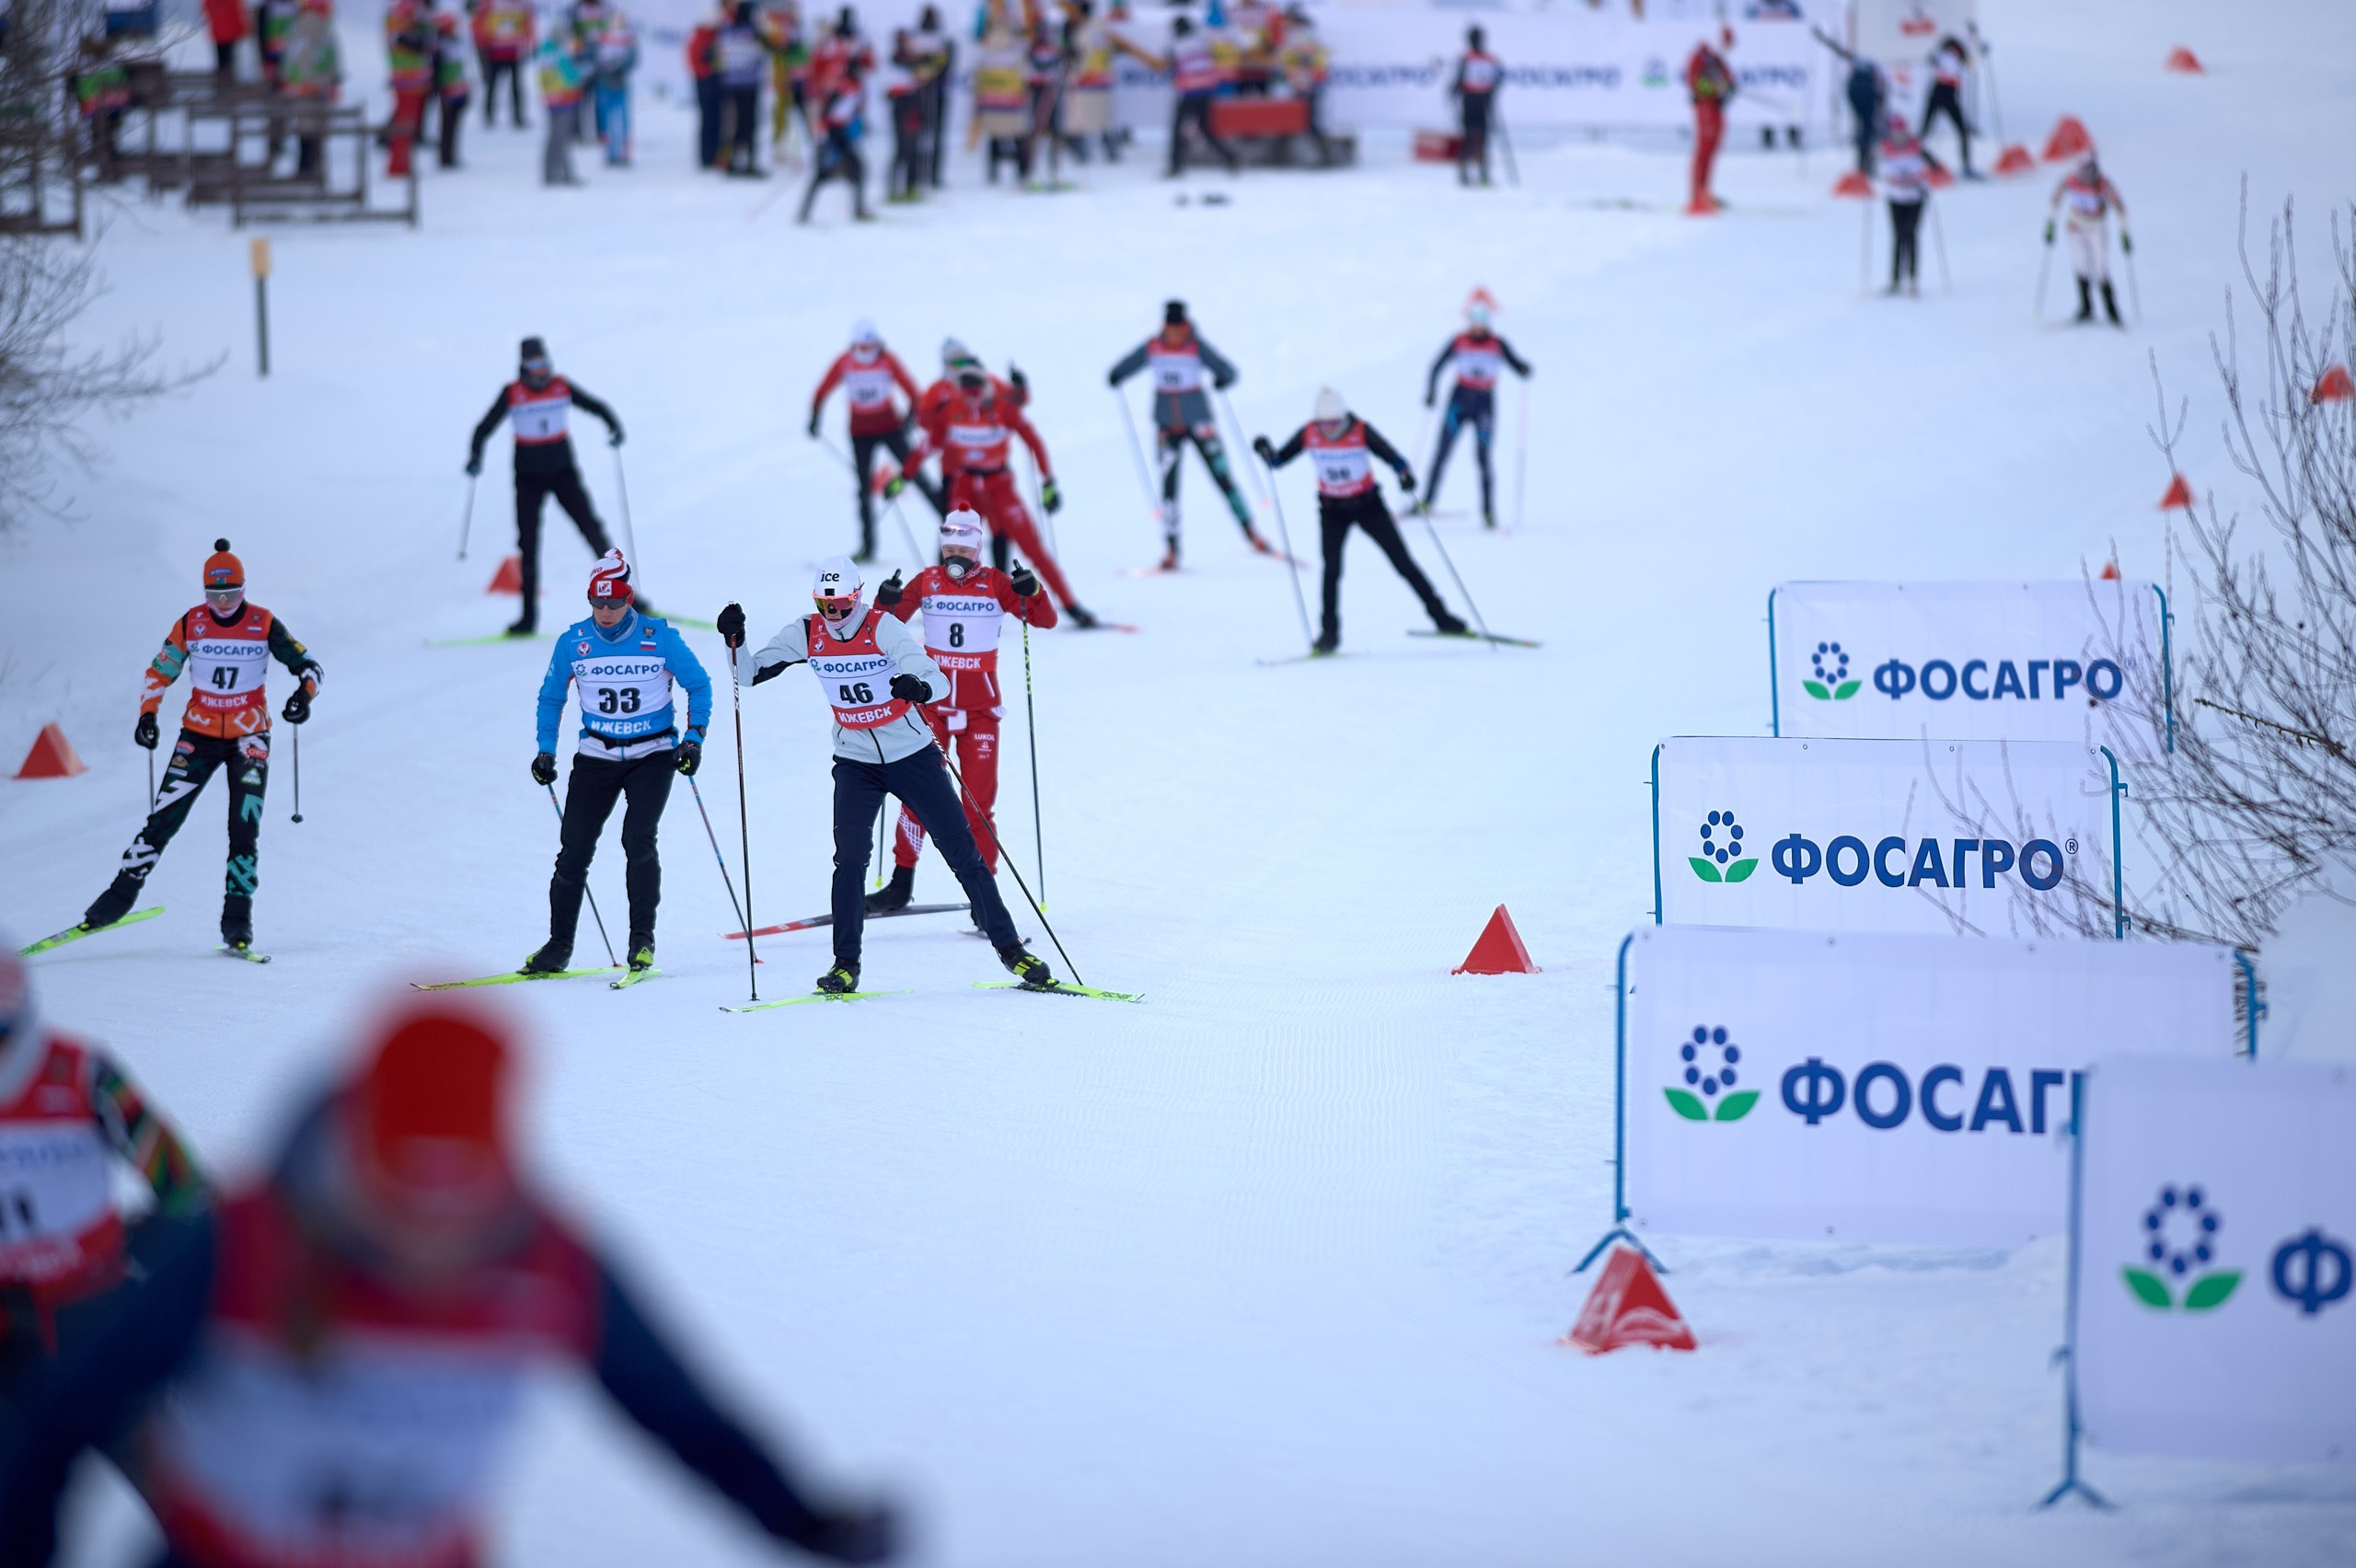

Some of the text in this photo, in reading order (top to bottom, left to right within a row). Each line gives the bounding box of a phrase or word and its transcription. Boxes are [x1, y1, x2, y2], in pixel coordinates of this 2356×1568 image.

[820, 570, 840, 582] ice
[936, 601, 995, 612] ФОСАГРО
[950, 622, 964, 648] 8
[202, 644, 264, 657] ФОСАГРО
[591, 663, 660, 675] ФОСАГРО
[824, 659, 888, 673] ФОСАГРО
[212, 666, 239, 690] 47
[598, 686, 641, 714] 33
[839, 682, 874, 704] 46
[200, 694, 248, 708] ИЖЕВСК
[837, 706, 893, 723] ИЖЕВСК
[591, 720, 652, 734] ИЖЕВСК
